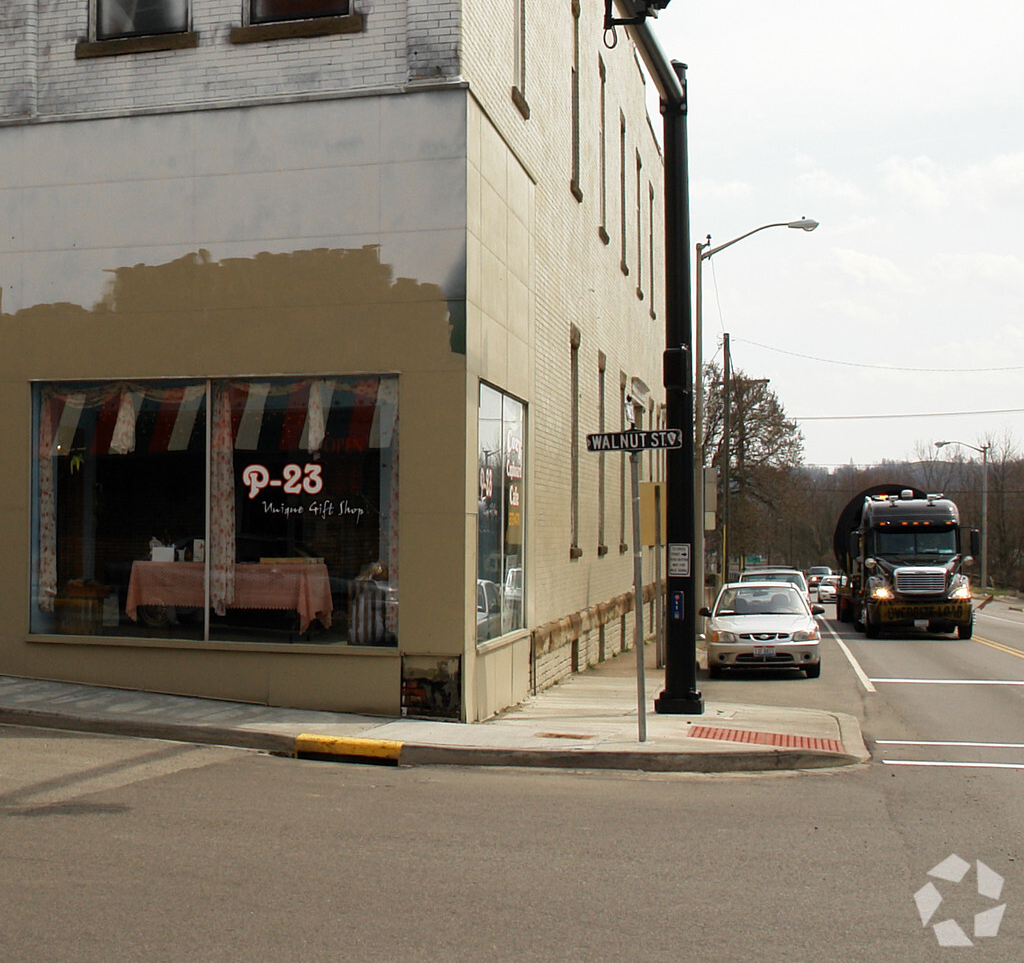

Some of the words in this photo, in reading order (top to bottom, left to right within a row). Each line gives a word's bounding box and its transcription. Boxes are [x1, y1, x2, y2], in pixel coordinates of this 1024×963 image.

[591, 433, 647, 450] WALNUT
[242, 463, 323, 499] P-23
[262, 500, 303, 520] Unique
[308, 499, 334, 520] Gift
[338, 499, 364, 524] Shop
